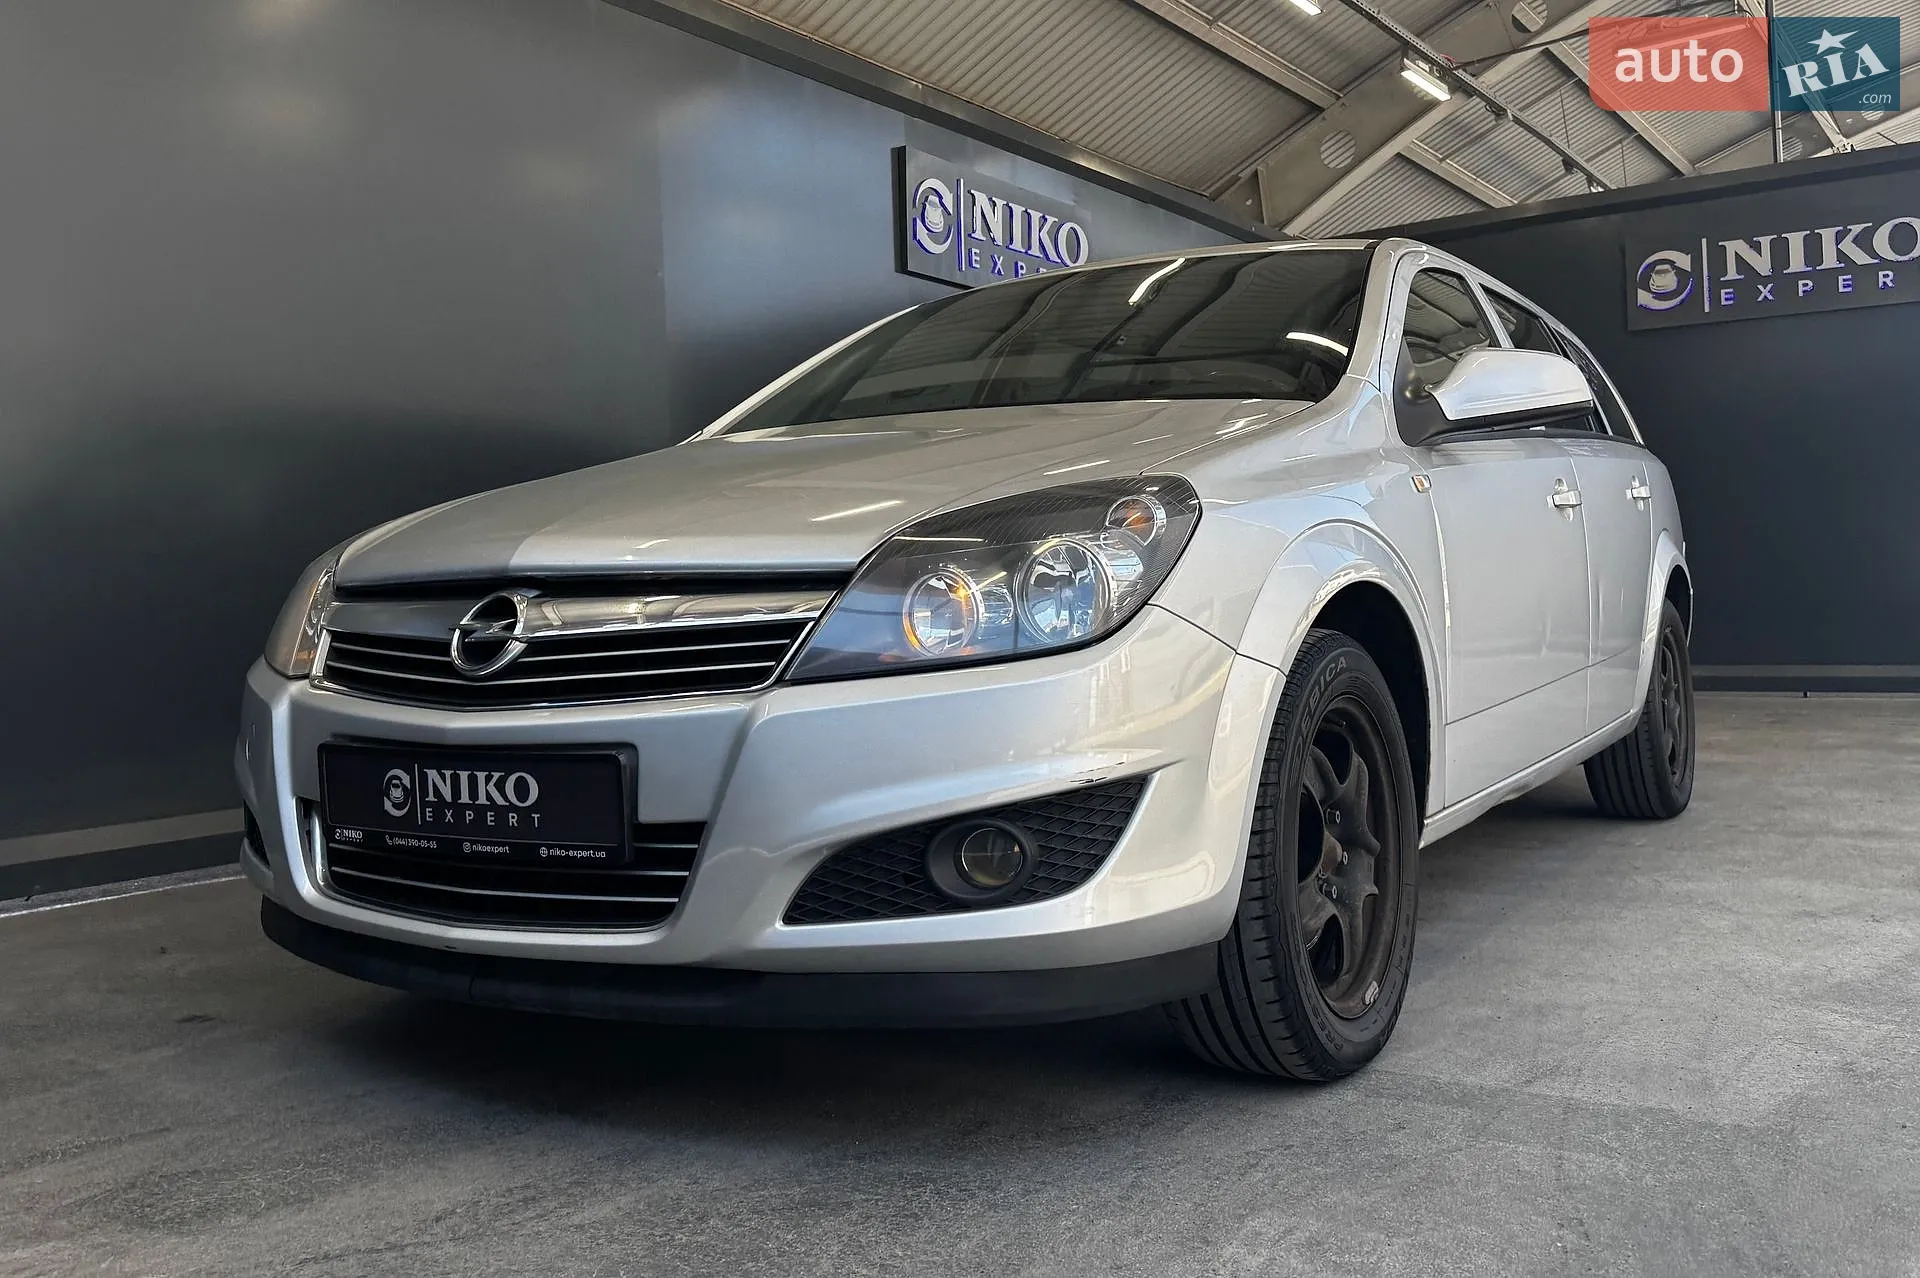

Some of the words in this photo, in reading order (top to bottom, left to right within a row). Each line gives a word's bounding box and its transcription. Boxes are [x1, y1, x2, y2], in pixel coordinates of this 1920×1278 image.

[968, 189, 1089, 267] NIKO
[968, 247, 1047, 279] EXP
[1718, 217, 1920, 281] NIKO
[423, 768, 539, 807] NIKO
[342, 829, 363, 839] NIKO
[425, 808, 541, 828] EXPERT
